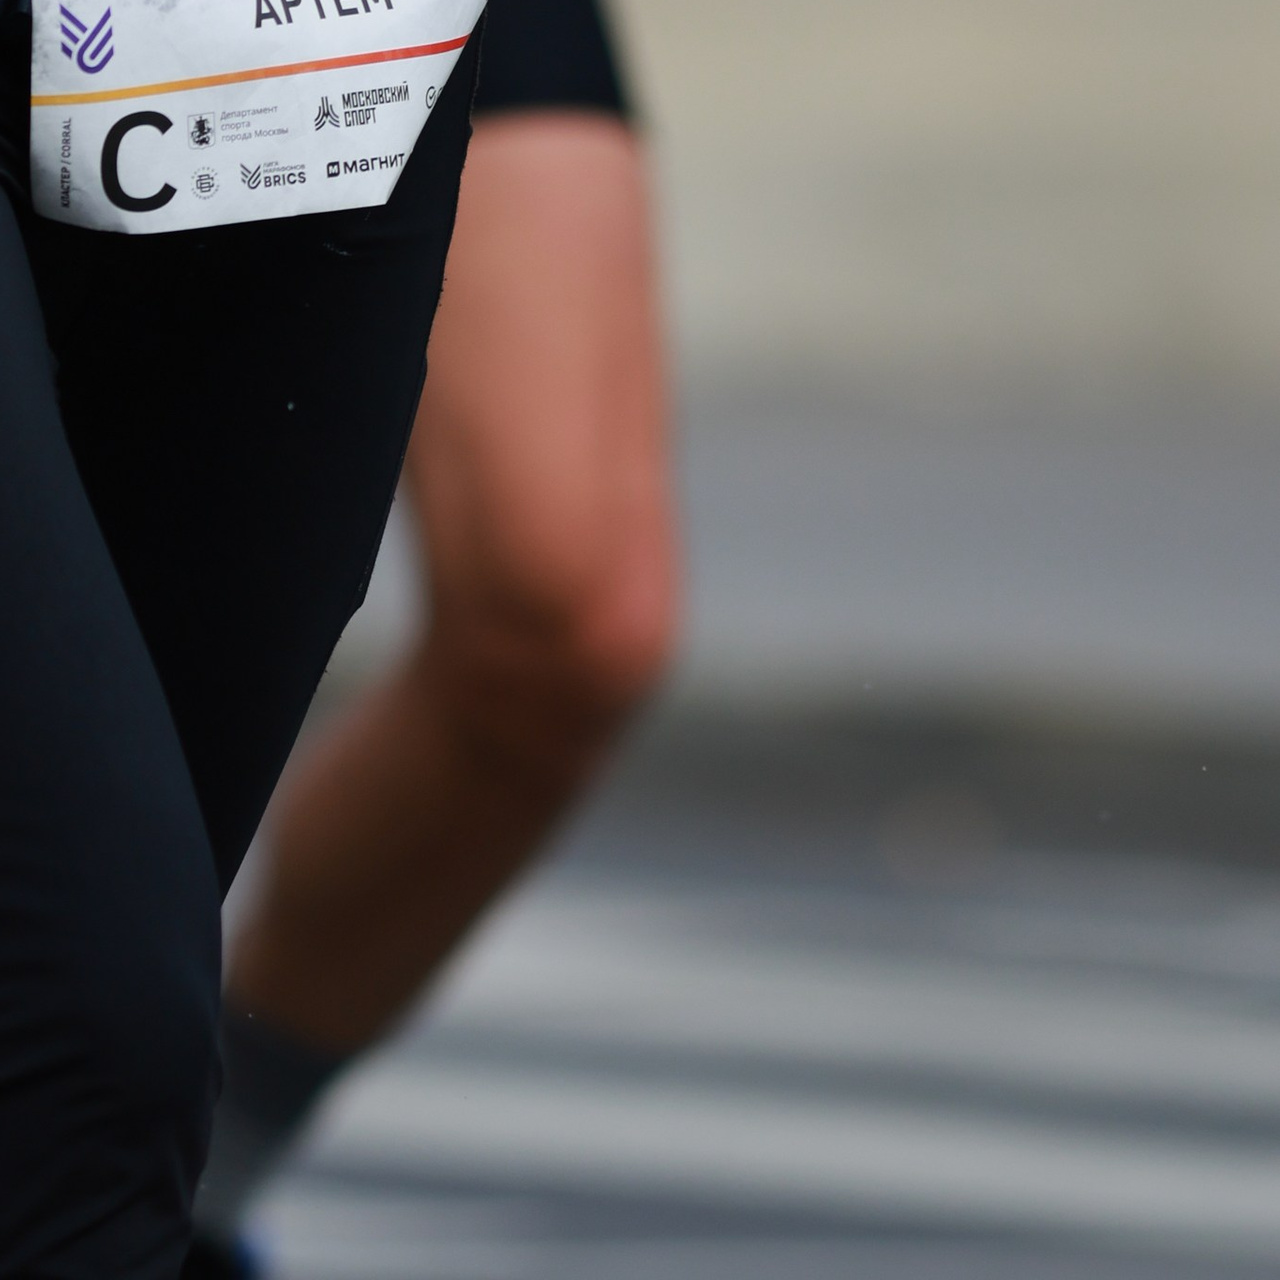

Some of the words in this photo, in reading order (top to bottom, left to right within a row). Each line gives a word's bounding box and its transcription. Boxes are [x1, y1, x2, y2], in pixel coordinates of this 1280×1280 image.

[341, 80, 410, 110] МОСКОВСКИЙ
[220, 105, 278, 121] Департамент
[344, 107, 377, 128] СПОРТ
[220, 121, 251, 131] спорта
[60, 118, 72, 159] CORRAL
[343, 152, 405, 175] магнит
[60, 166, 71, 209] КЛАСТЕР
[264, 171, 307, 189] BRICS
